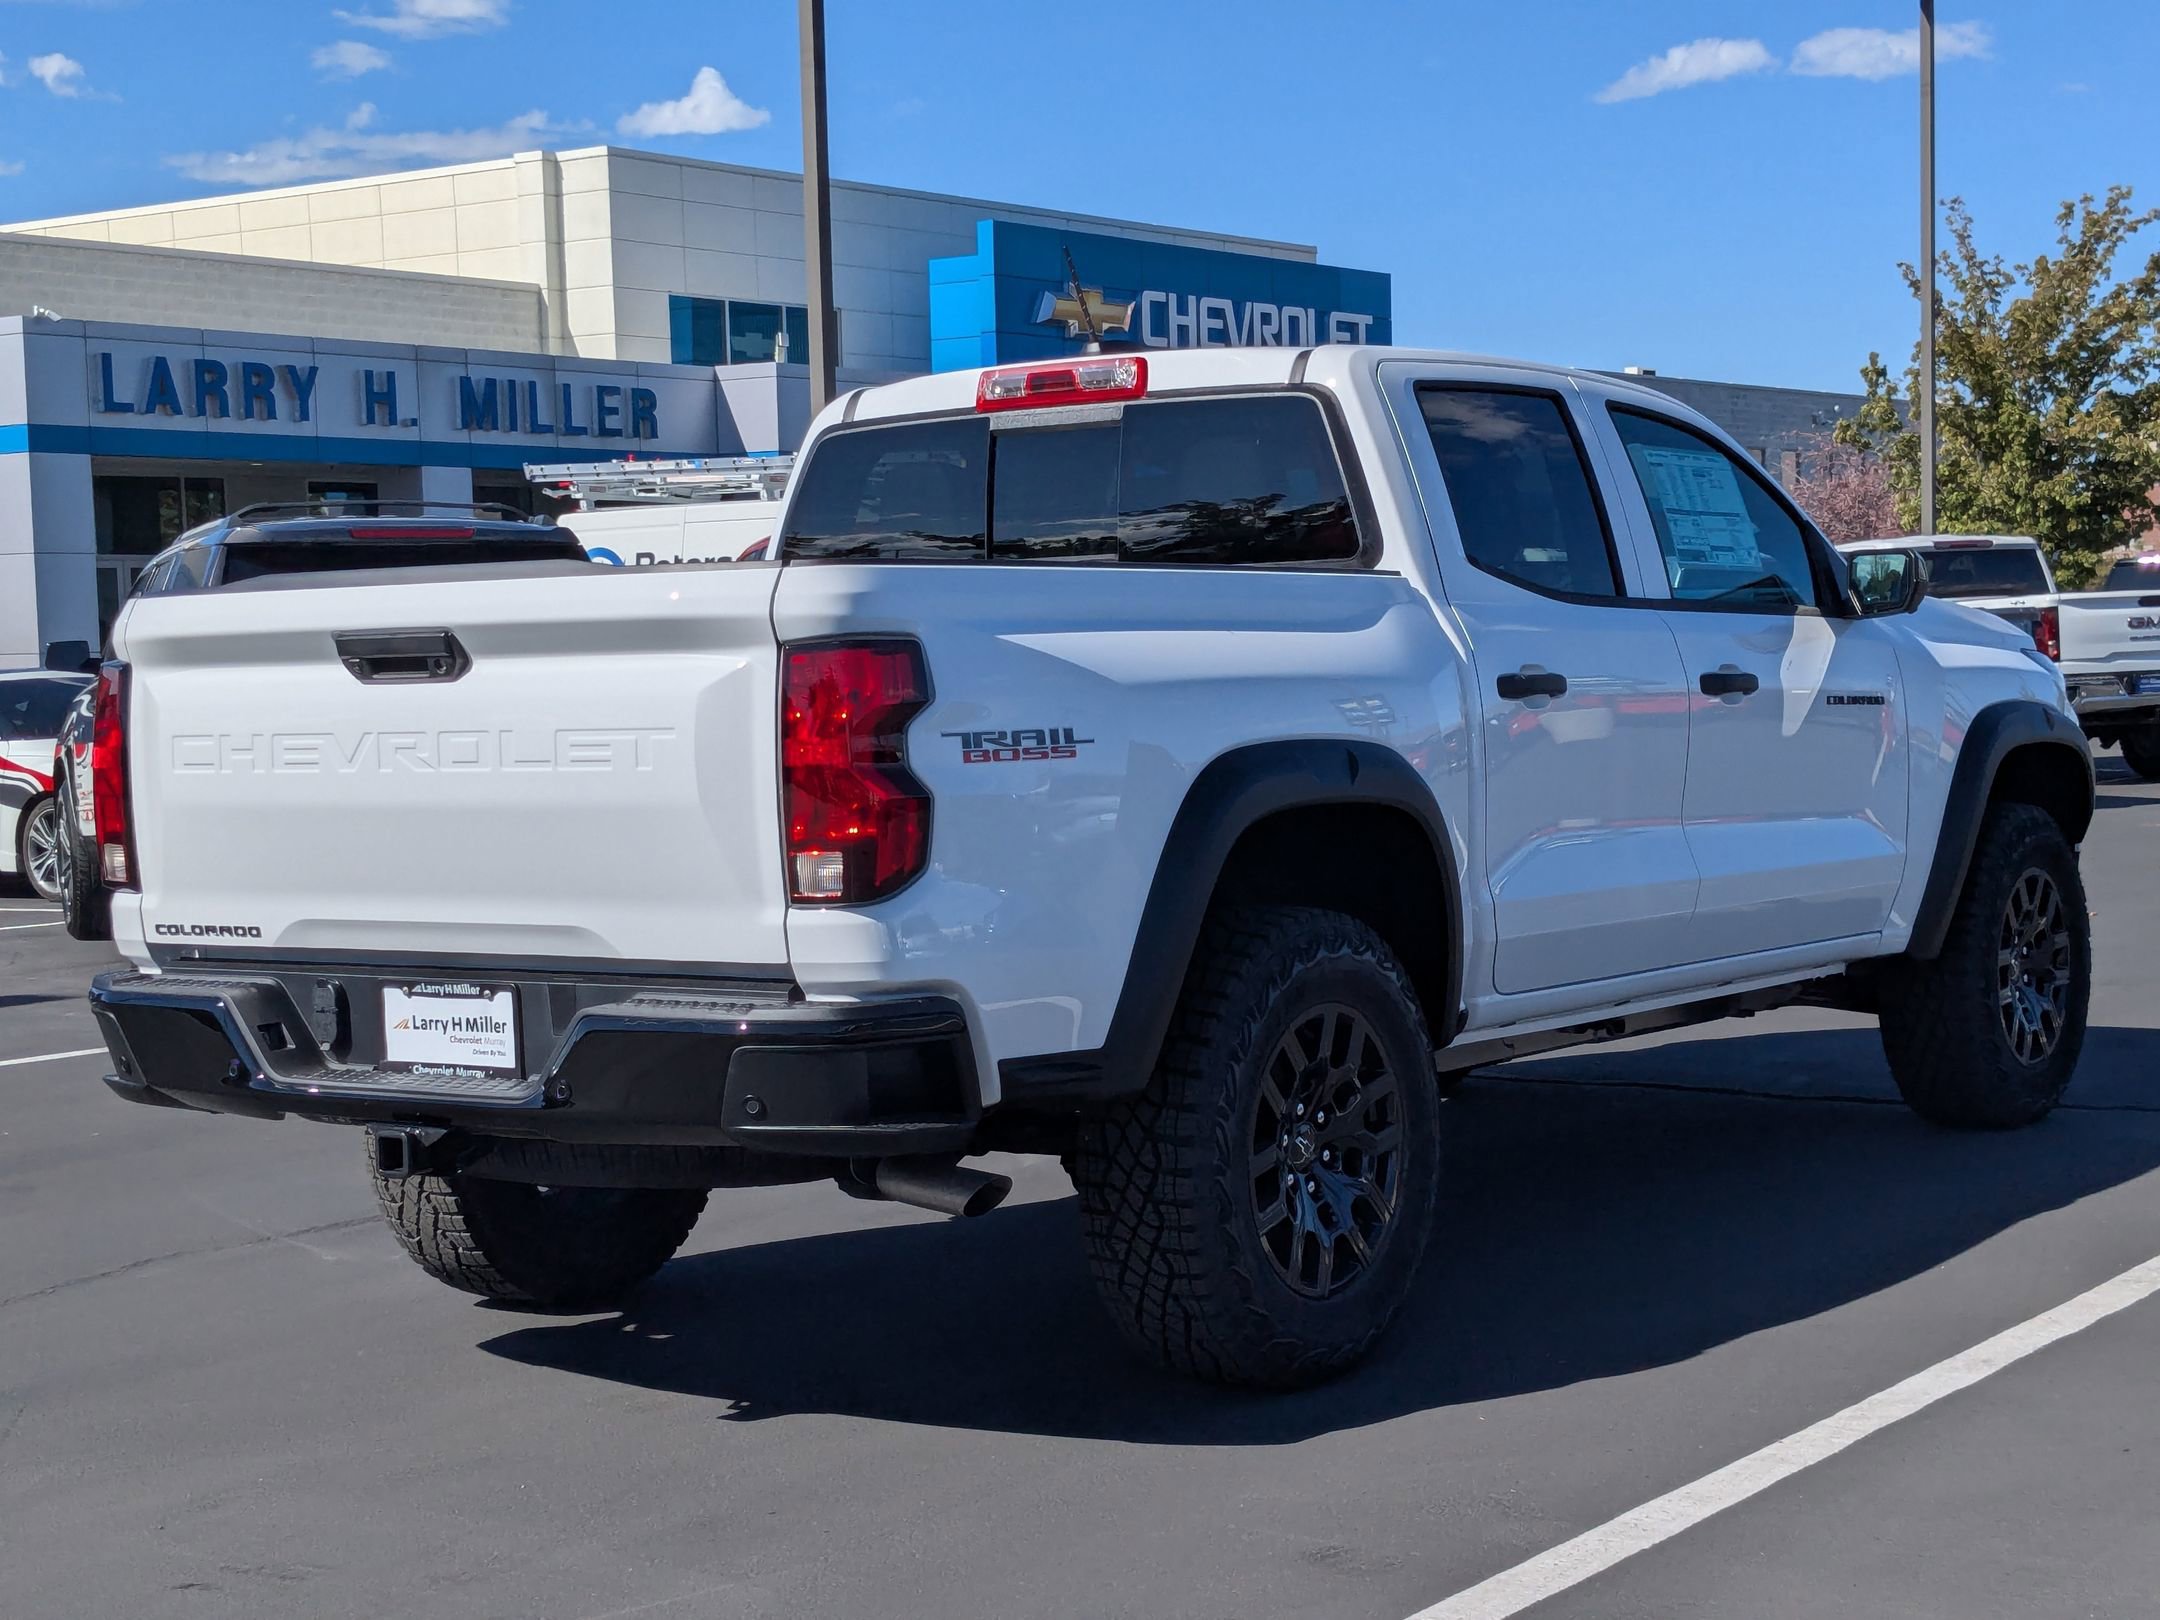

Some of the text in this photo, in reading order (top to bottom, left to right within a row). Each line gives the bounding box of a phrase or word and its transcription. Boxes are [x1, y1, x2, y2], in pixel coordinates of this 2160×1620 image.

[1142, 290, 1374, 348] CHEVROLET
[101, 352, 659, 439] LARRY H. MILLER
[941, 727, 1095, 750] TRAIL
[172, 726, 676, 774] CHEVROLET
[962, 745, 1077, 764] BOSS
[155, 924, 262, 938] COLORADO
[421, 983, 480, 996] Larry H Miller
[412, 1014, 507, 1035] Larry H Miller
[450, 1035, 506, 1047] Chevrolet Murray
[413, 1064, 486, 1078] Chevrolet Murray
